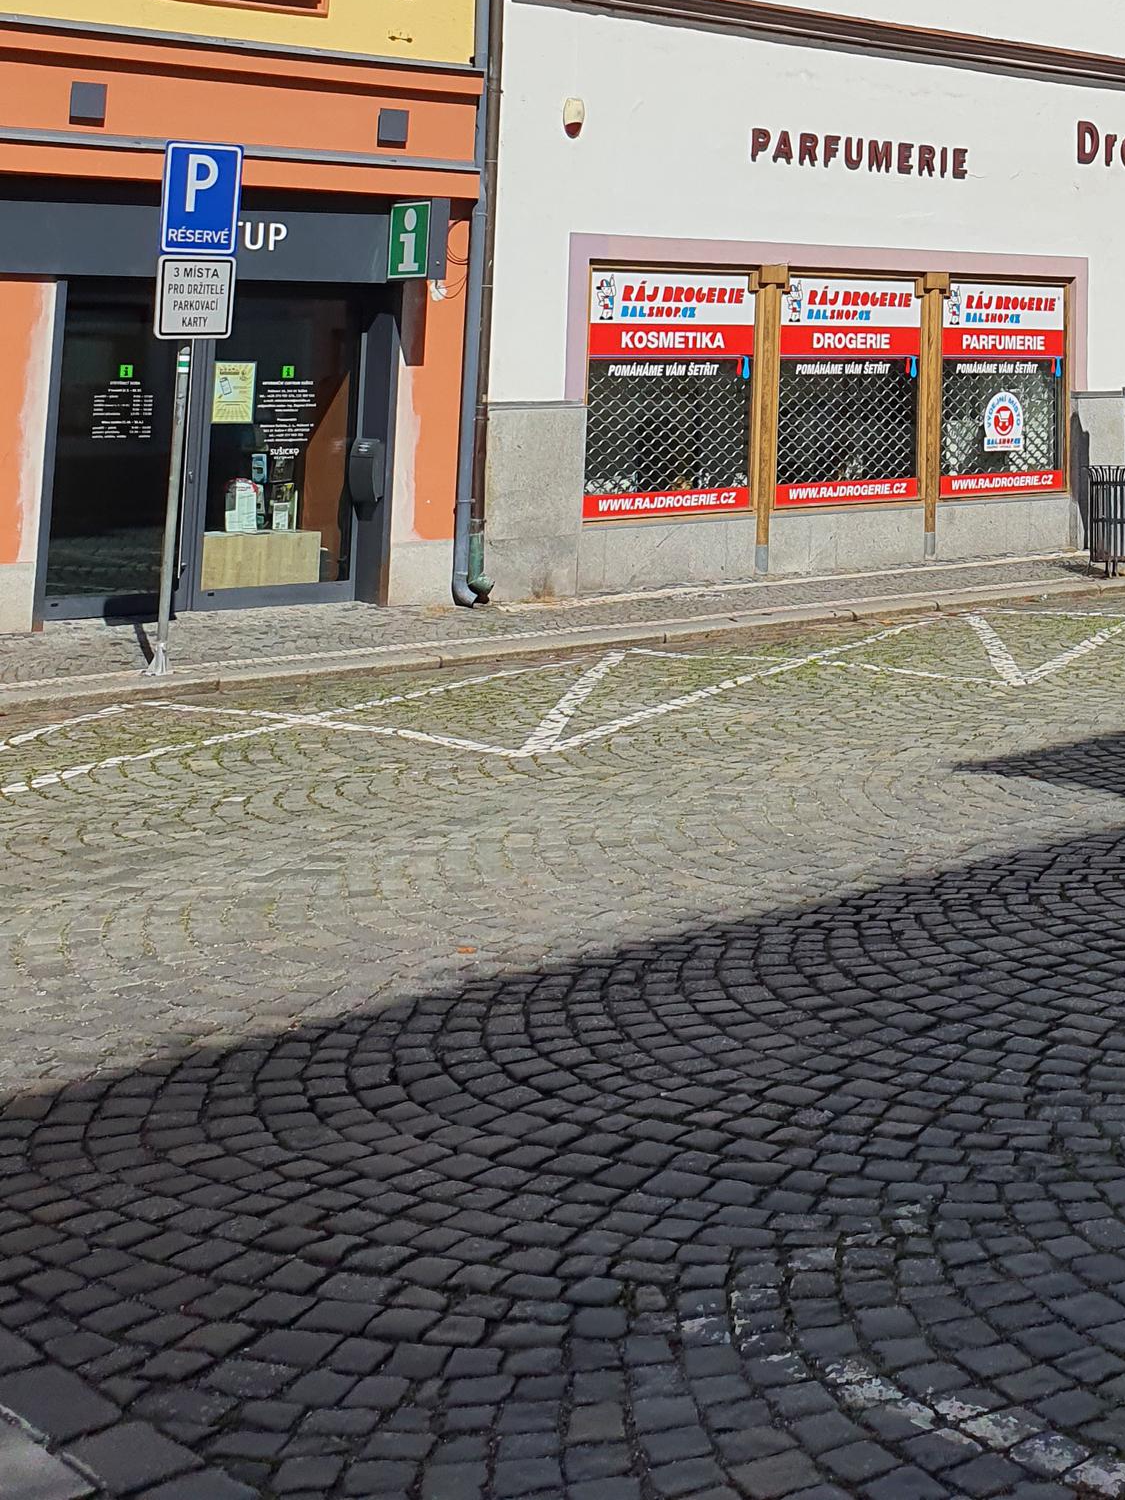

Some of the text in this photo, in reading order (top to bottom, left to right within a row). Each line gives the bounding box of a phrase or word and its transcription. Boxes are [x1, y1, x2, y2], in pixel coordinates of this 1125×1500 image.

[751, 128, 968, 179] PARFUMERIE
[185, 154, 219, 212] P
[168, 225, 229, 244] RÉSERVÉ
[238, 221, 288, 251] UP
[173, 265, 220, 278] 3 MÍSTA
[168, 282, 225, 295] PRO DRŽITELE
[622, 281, 745, 304] RÁJ DROGERIE
[808, 286, 912, 307] RÁJ DROGERIE
[173, 298, 219, 311] PARKOVACÍ
[965, 291, 1056, 311] RÁJ DROGERIE
[181, 316, 208, 327] KARTY
[620, 331, 725, 349] KOSMETIKA
[812, 332, 891, 349] DROGERIE
[962, 334, 1045, 350] PARFUMERIE
[608, 361, 719, 377] POMÁHÁME VÁM ŠETŘIT
[796, 361, 890, 375] POMÁHÁME VÁM ŠETŘIT
[956, 361, 1038, 374] POMÁHÁME VÁM ŠETŘIT
[789, 482, 907, 500] WWW.RAJDROGERIE.CZ
[951, 473, 1053, 491] WWW.RAJDROGERIE.CZ
[598, 491, 736, 512] WWW.RAJDROGERIE.CZ
